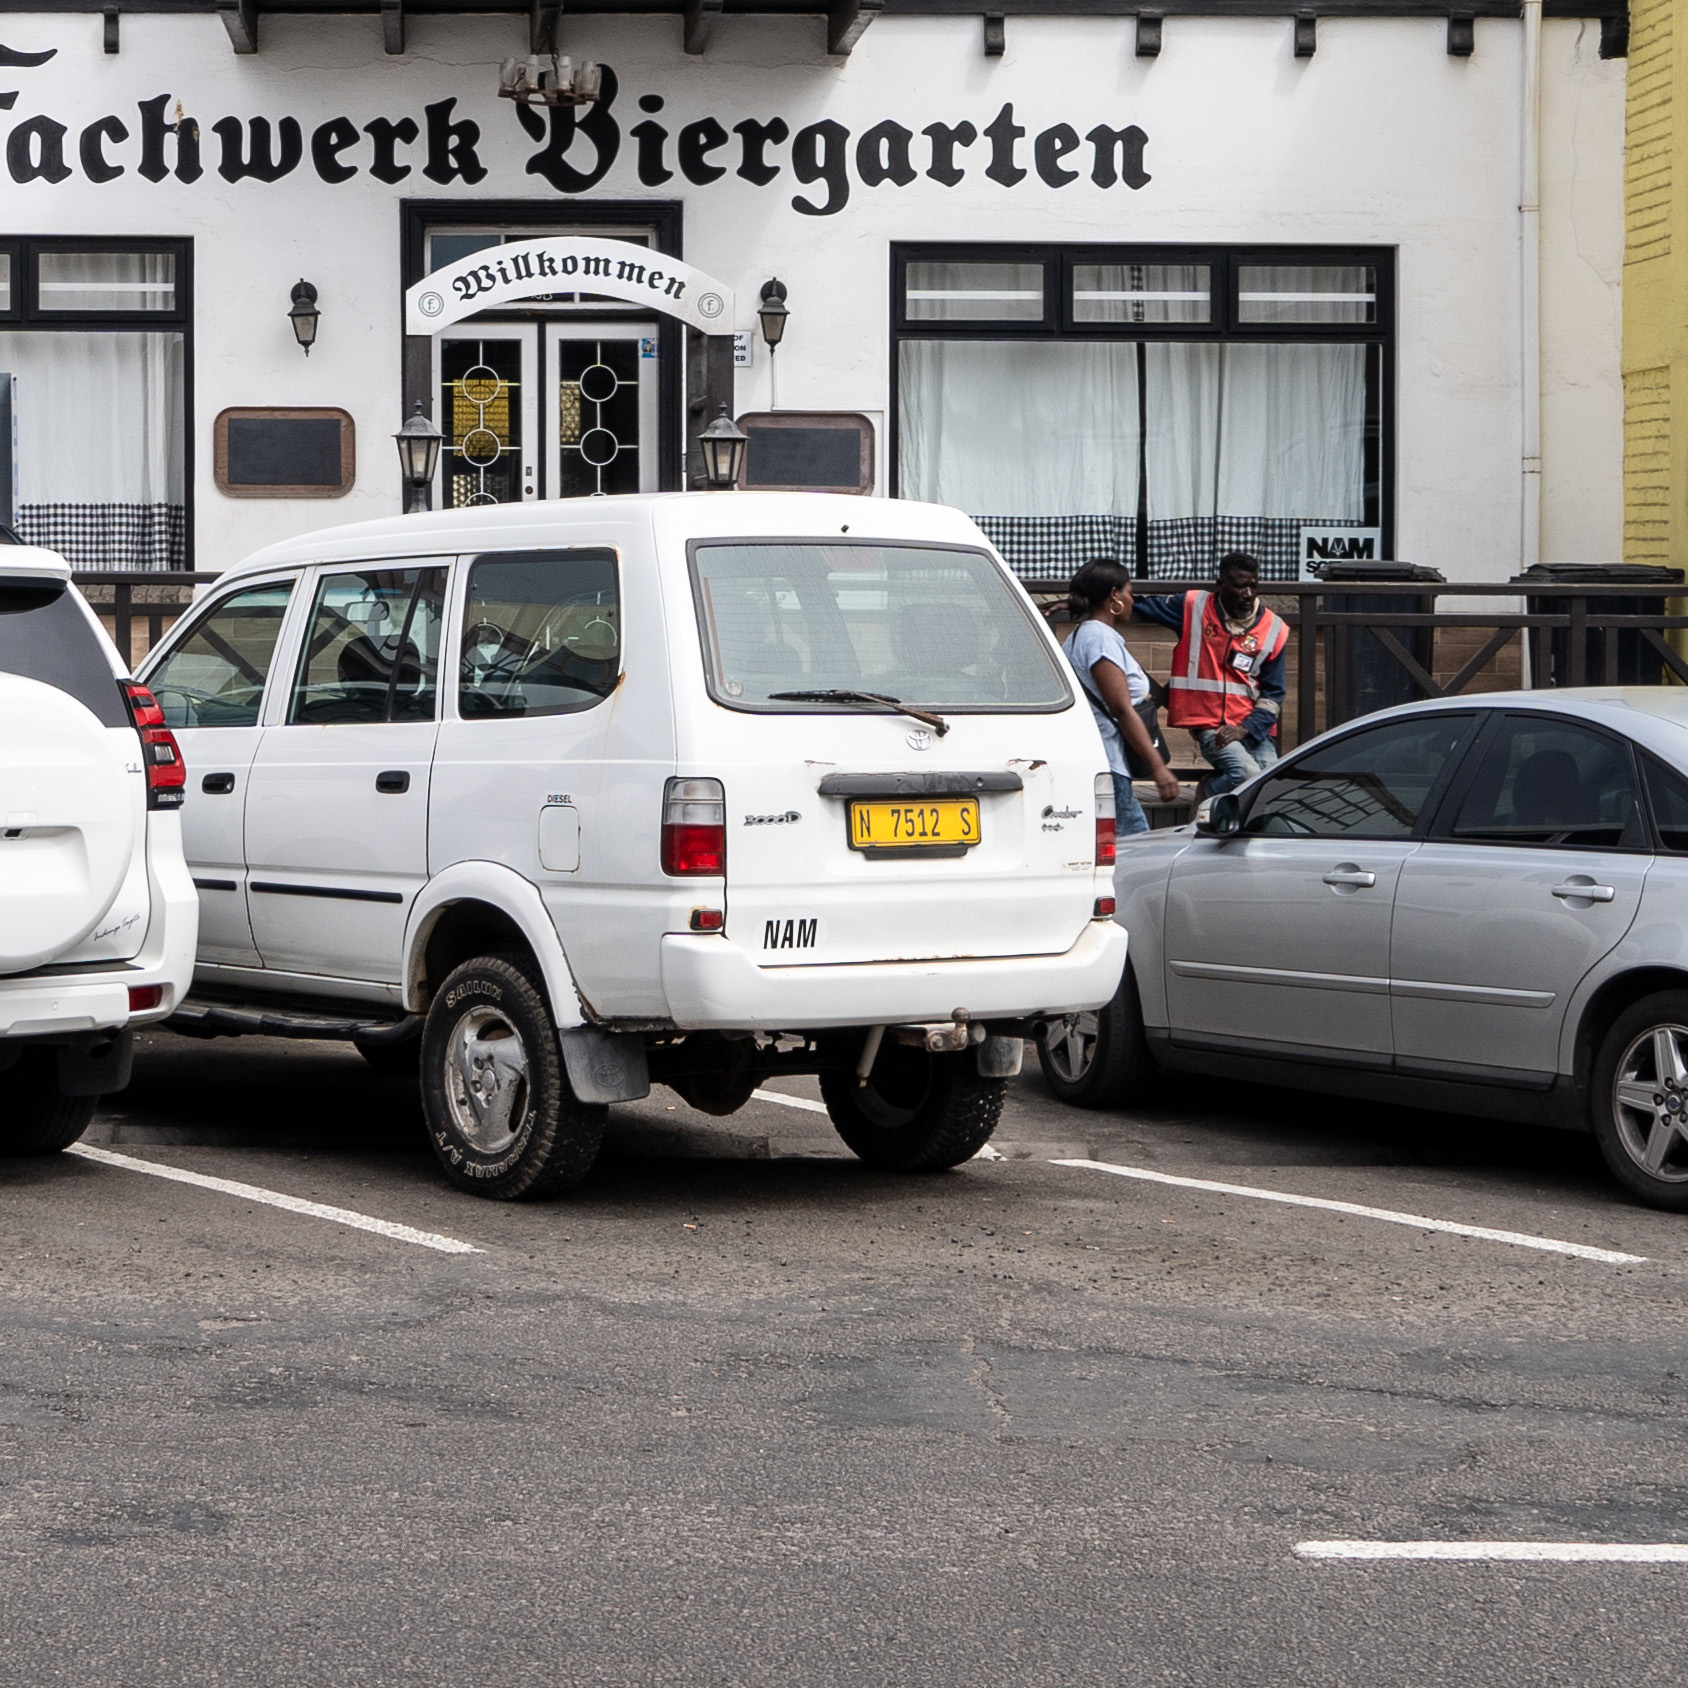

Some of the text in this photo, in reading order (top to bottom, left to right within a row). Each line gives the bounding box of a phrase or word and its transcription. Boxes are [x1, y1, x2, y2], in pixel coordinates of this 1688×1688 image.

[515, 62, 1154, 216] Biergarten
[452, 249, 686, 301] Willkommen
[1306, 536, 1375, 560] NAM
[547, 794, 573, 803] DIESEL
[859, 807, 972, 839] N 7512 S
[763, 918, 818, 950] NAM
